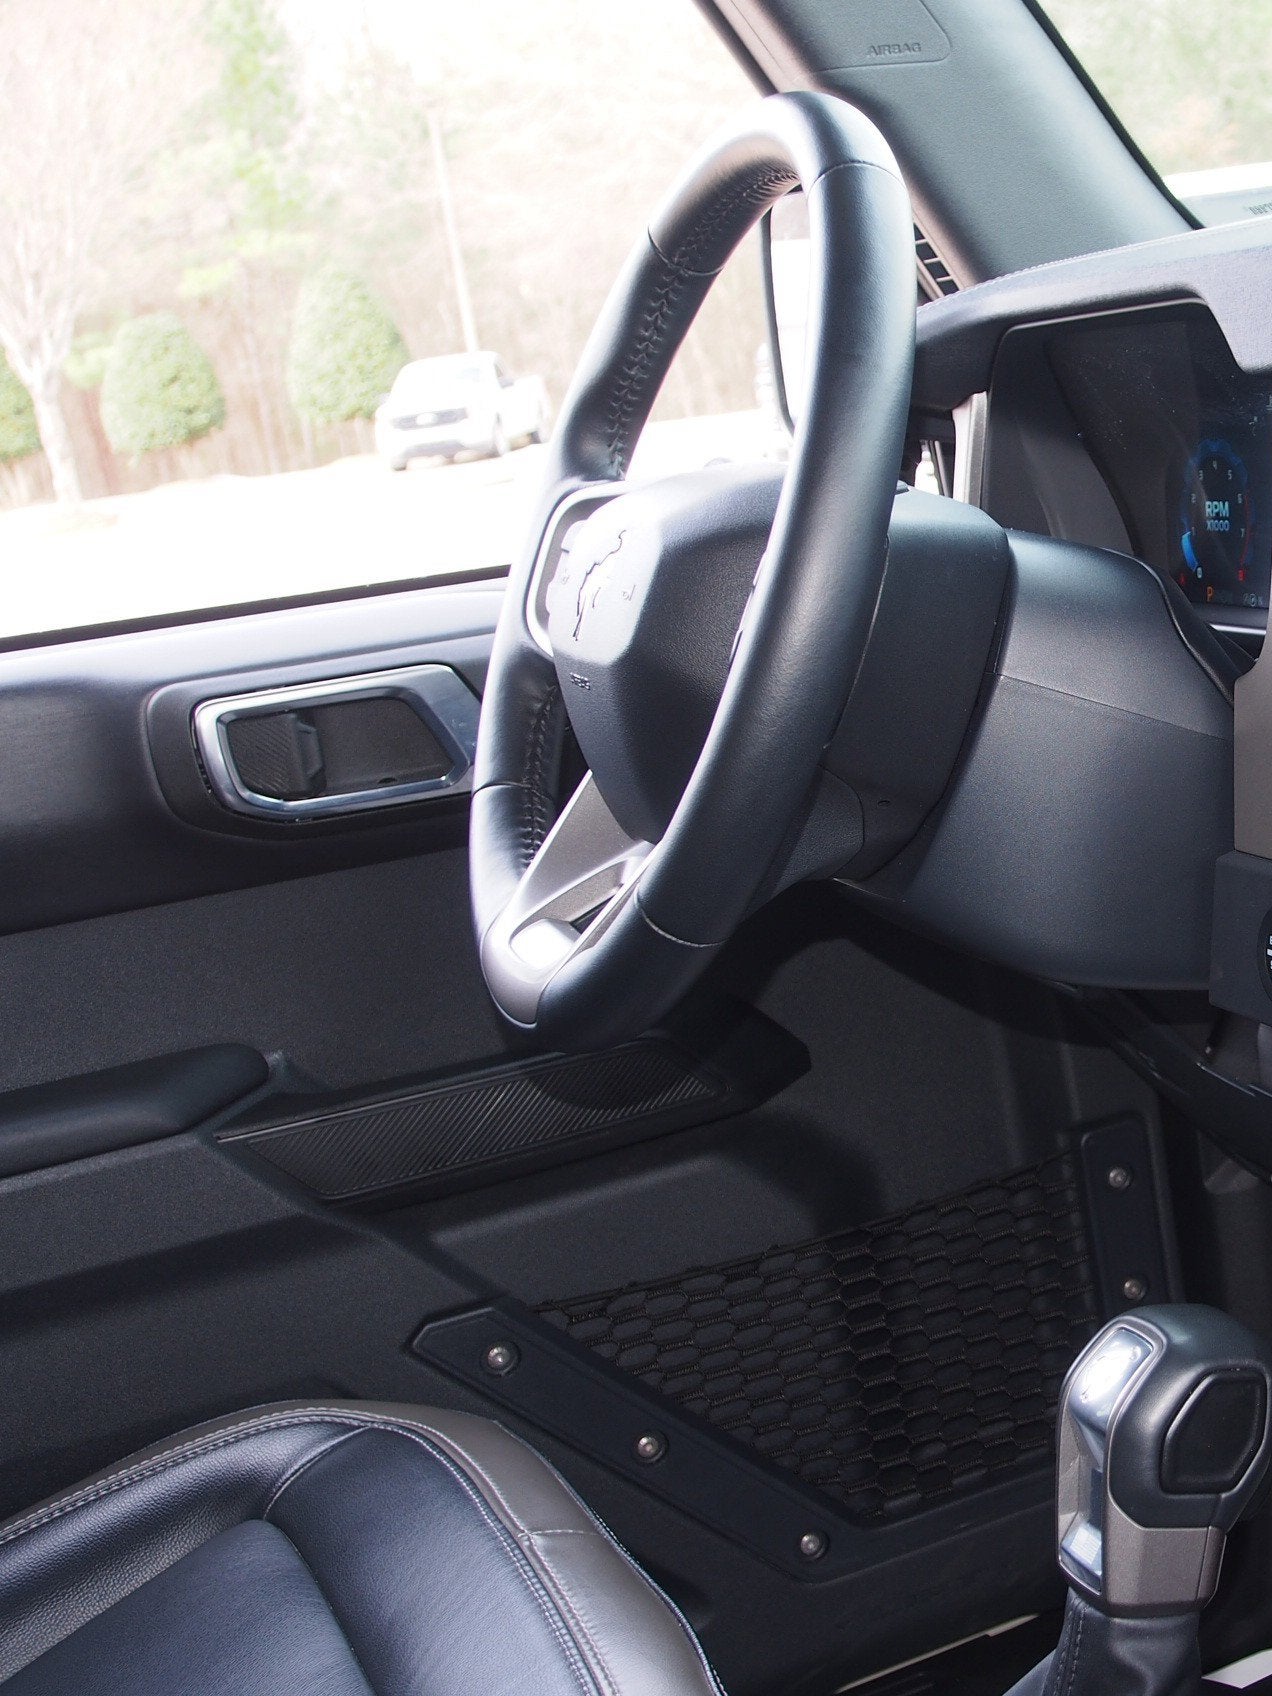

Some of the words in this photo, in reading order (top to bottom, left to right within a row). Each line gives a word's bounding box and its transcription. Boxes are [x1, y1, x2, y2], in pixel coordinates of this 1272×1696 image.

[865, 42, 922, 56] AIRBAG
[1205, 500, 1230, 517] RPM
[1206, 586, 1214, 602] P
